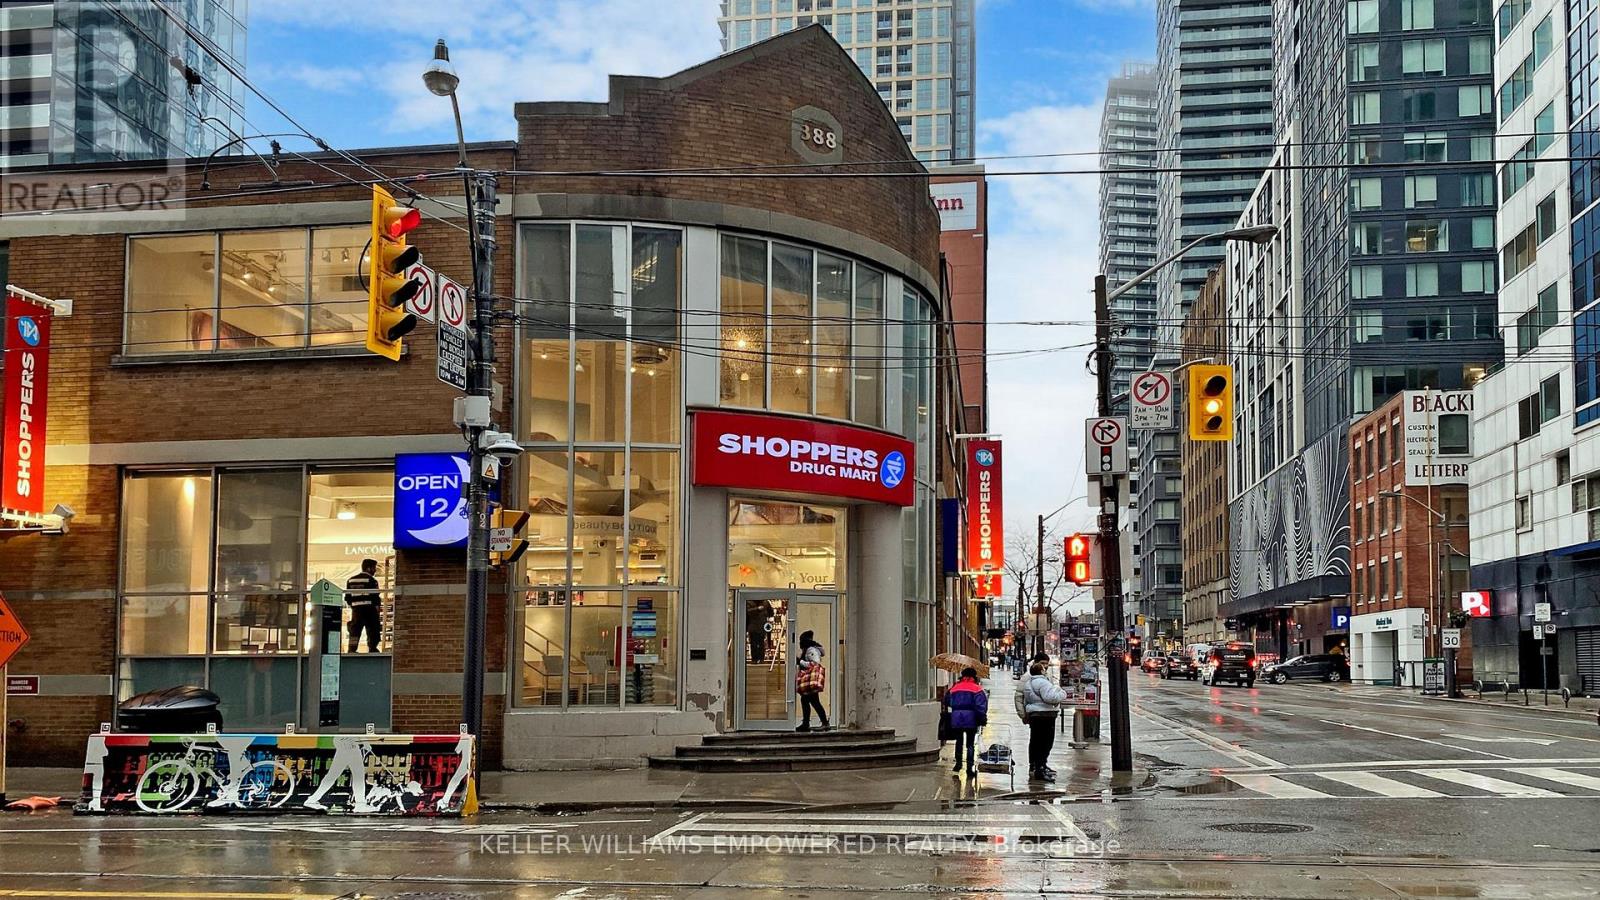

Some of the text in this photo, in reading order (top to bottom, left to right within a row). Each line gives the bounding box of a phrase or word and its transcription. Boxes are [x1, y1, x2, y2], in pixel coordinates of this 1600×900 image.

[801, 125, 837, 149] 388
[930, 196, 964, 210] nn
[1412, 394, 1473, 412] BLACK
[17, 352, 35, 498] SHOPPERS
[1156, 413, 1168, 421] 7PM
[718, 433, 878, 469] SHOPPERS
[790, 461, 877, 482] DRUG MART
[1415, 464, 1468, 477] LETTERP
[398, 475, 459, 490] OPEN
[416, 497, 449, 518] 12
[979, 470, 992, 560] SHOPPERS
[800, 573, 828, 583] Your
[1337, 615, 1347, 627] P
[1444, 636, 1459, 646] 30
